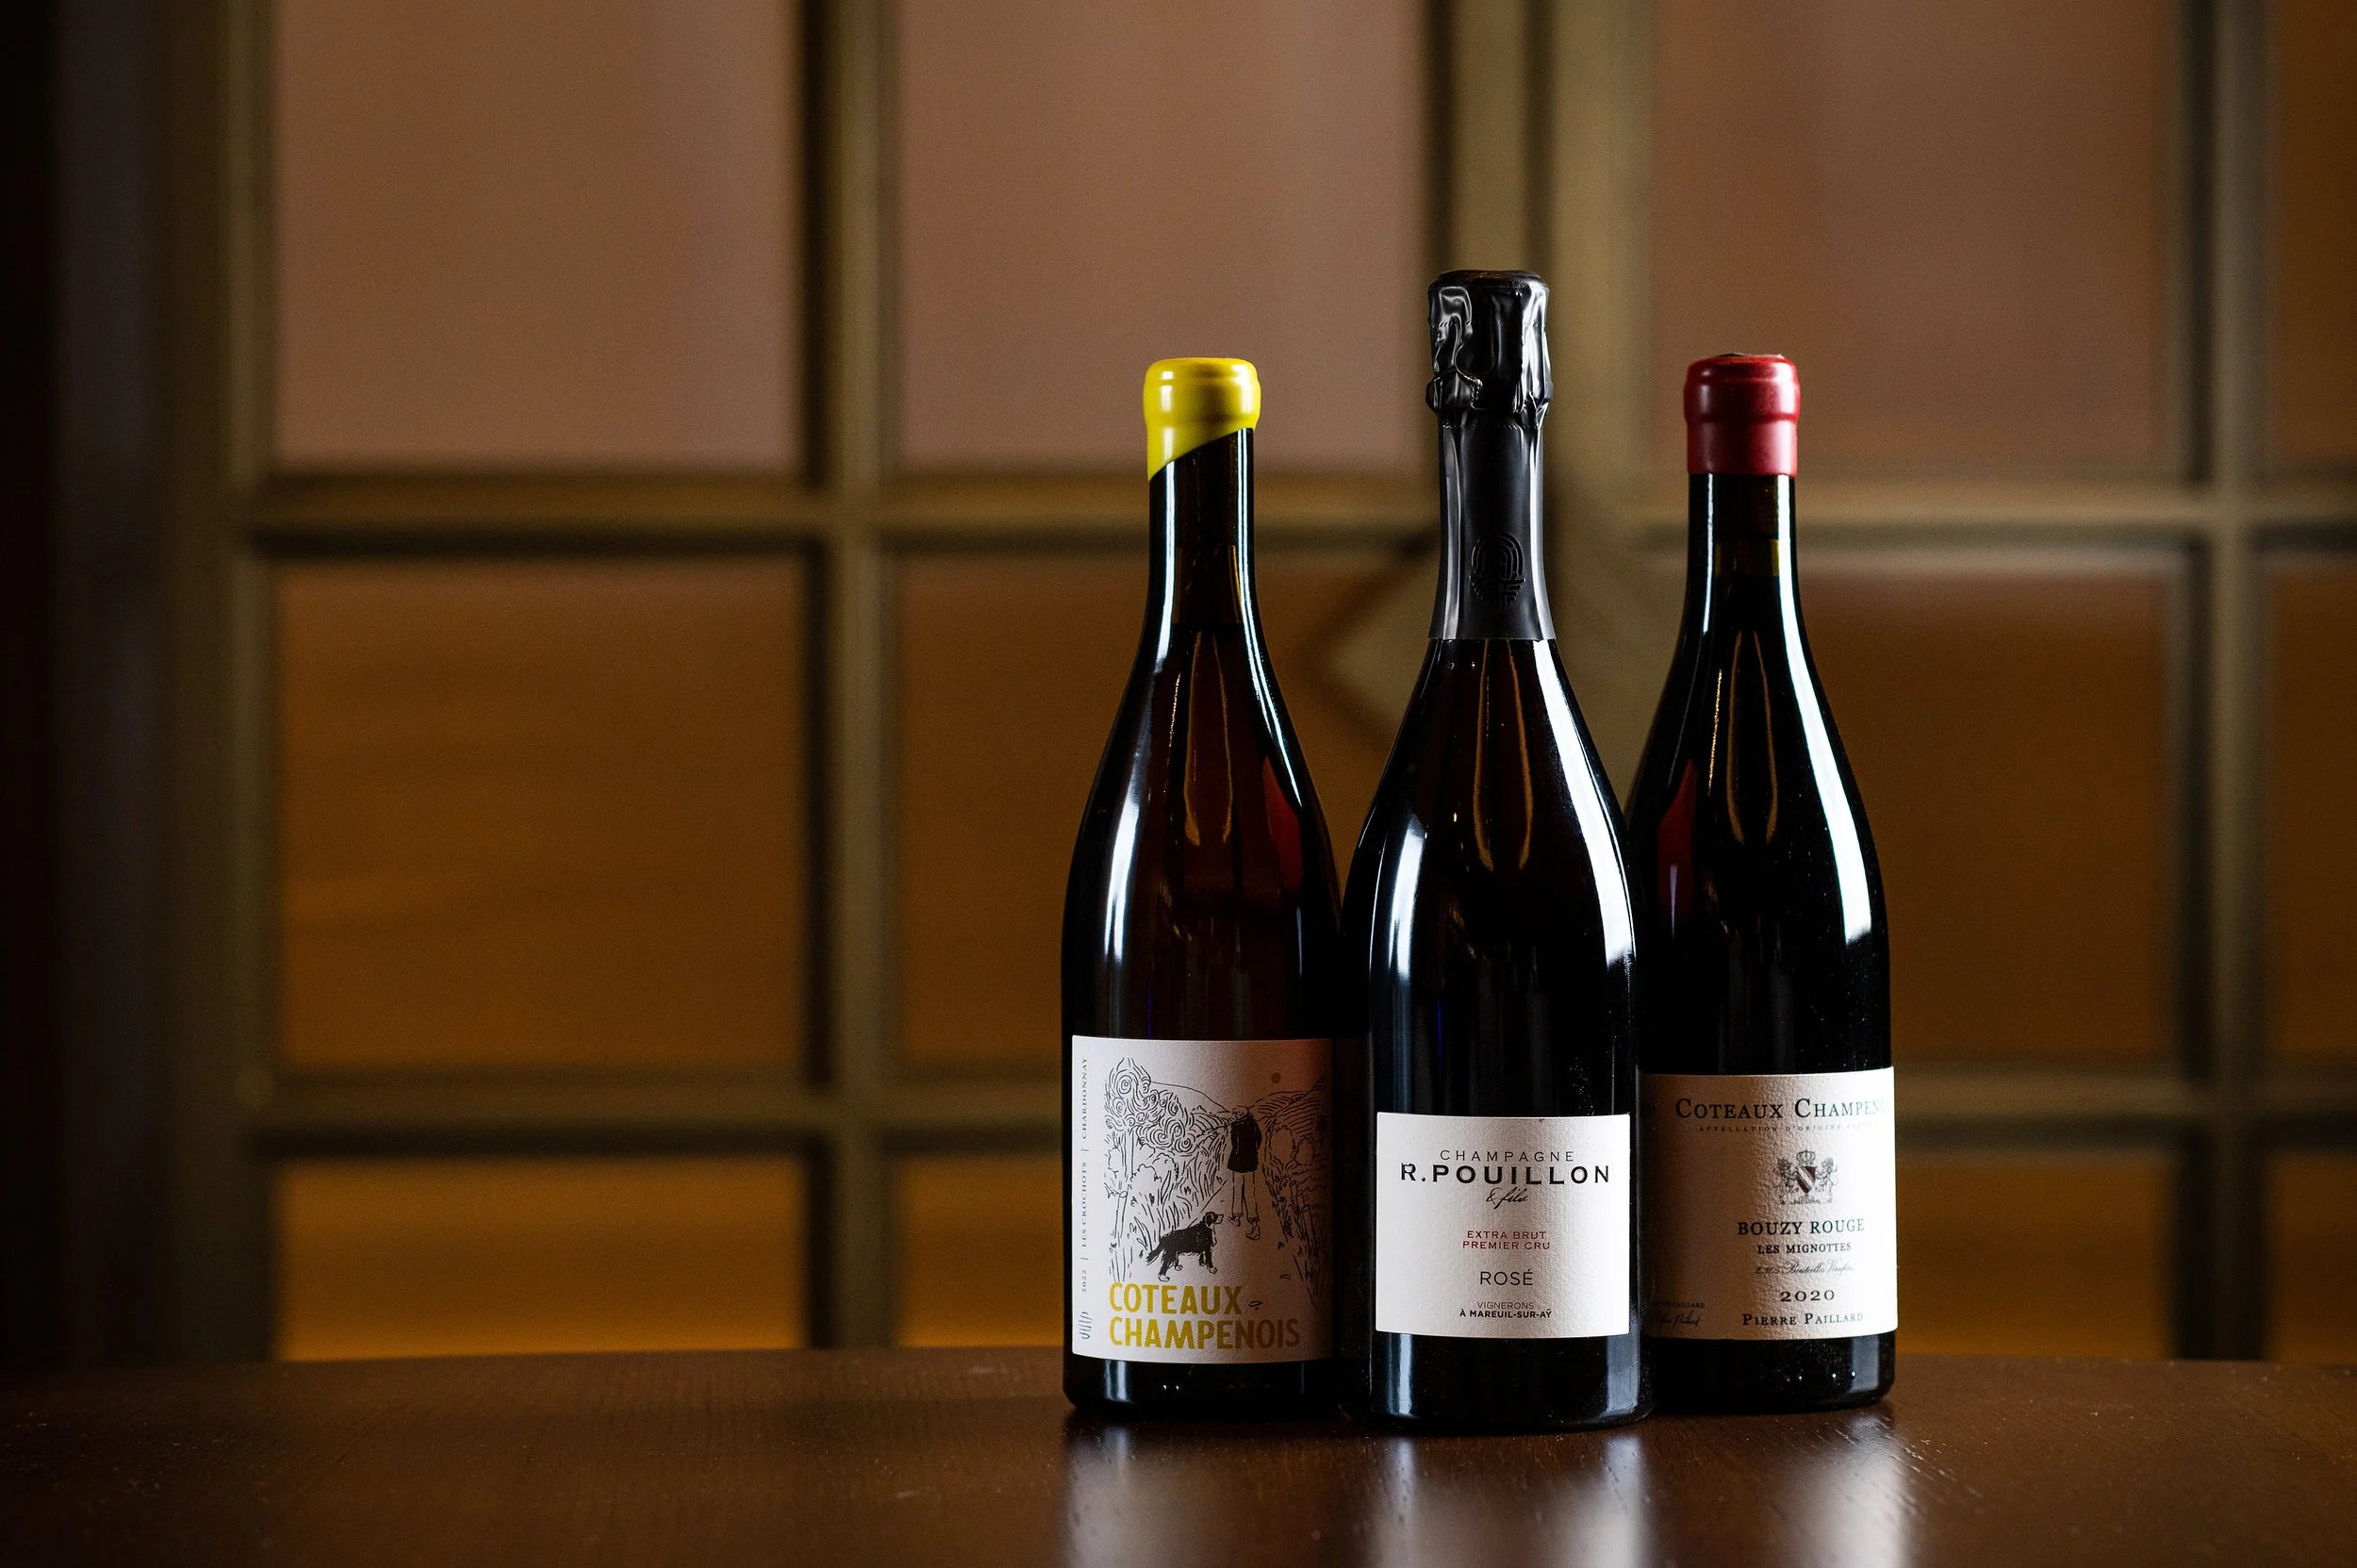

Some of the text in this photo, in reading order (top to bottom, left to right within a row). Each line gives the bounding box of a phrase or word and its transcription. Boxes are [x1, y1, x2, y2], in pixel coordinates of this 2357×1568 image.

[1675, 1098, 1783, 1119] COTEAUX
[1440, 1149, 1574, 1163] CHAMPAGNE
[1495, 1186, 1528, 1209] fils
[1738, 1218, 1865, 1236] BOUZY ROUGE
[1467, 1230, 1547, 1240] EXTRA BRUT
[1462, 1241, 1551, 1250] PREMIER CRU
[1757, 1242, 1852, 1254] LES MIGNOTTES
[1479, 1269, 1534, 1286] ROSÉ
[1109, 1282, 1244, 1315] COTEAUX
[1780, 1289, 1835, 1302] 2020
[1476, 1301, 1535, 1310] VIGNERONS
[1459, 1308, 1552, 1318] À MAREUIL-SUR-AŸ
[1741, 1312, 1864, 1326] PIERRE PAILLARD
[1109, 1315, 1300, 1350] CHAMPENOIS
